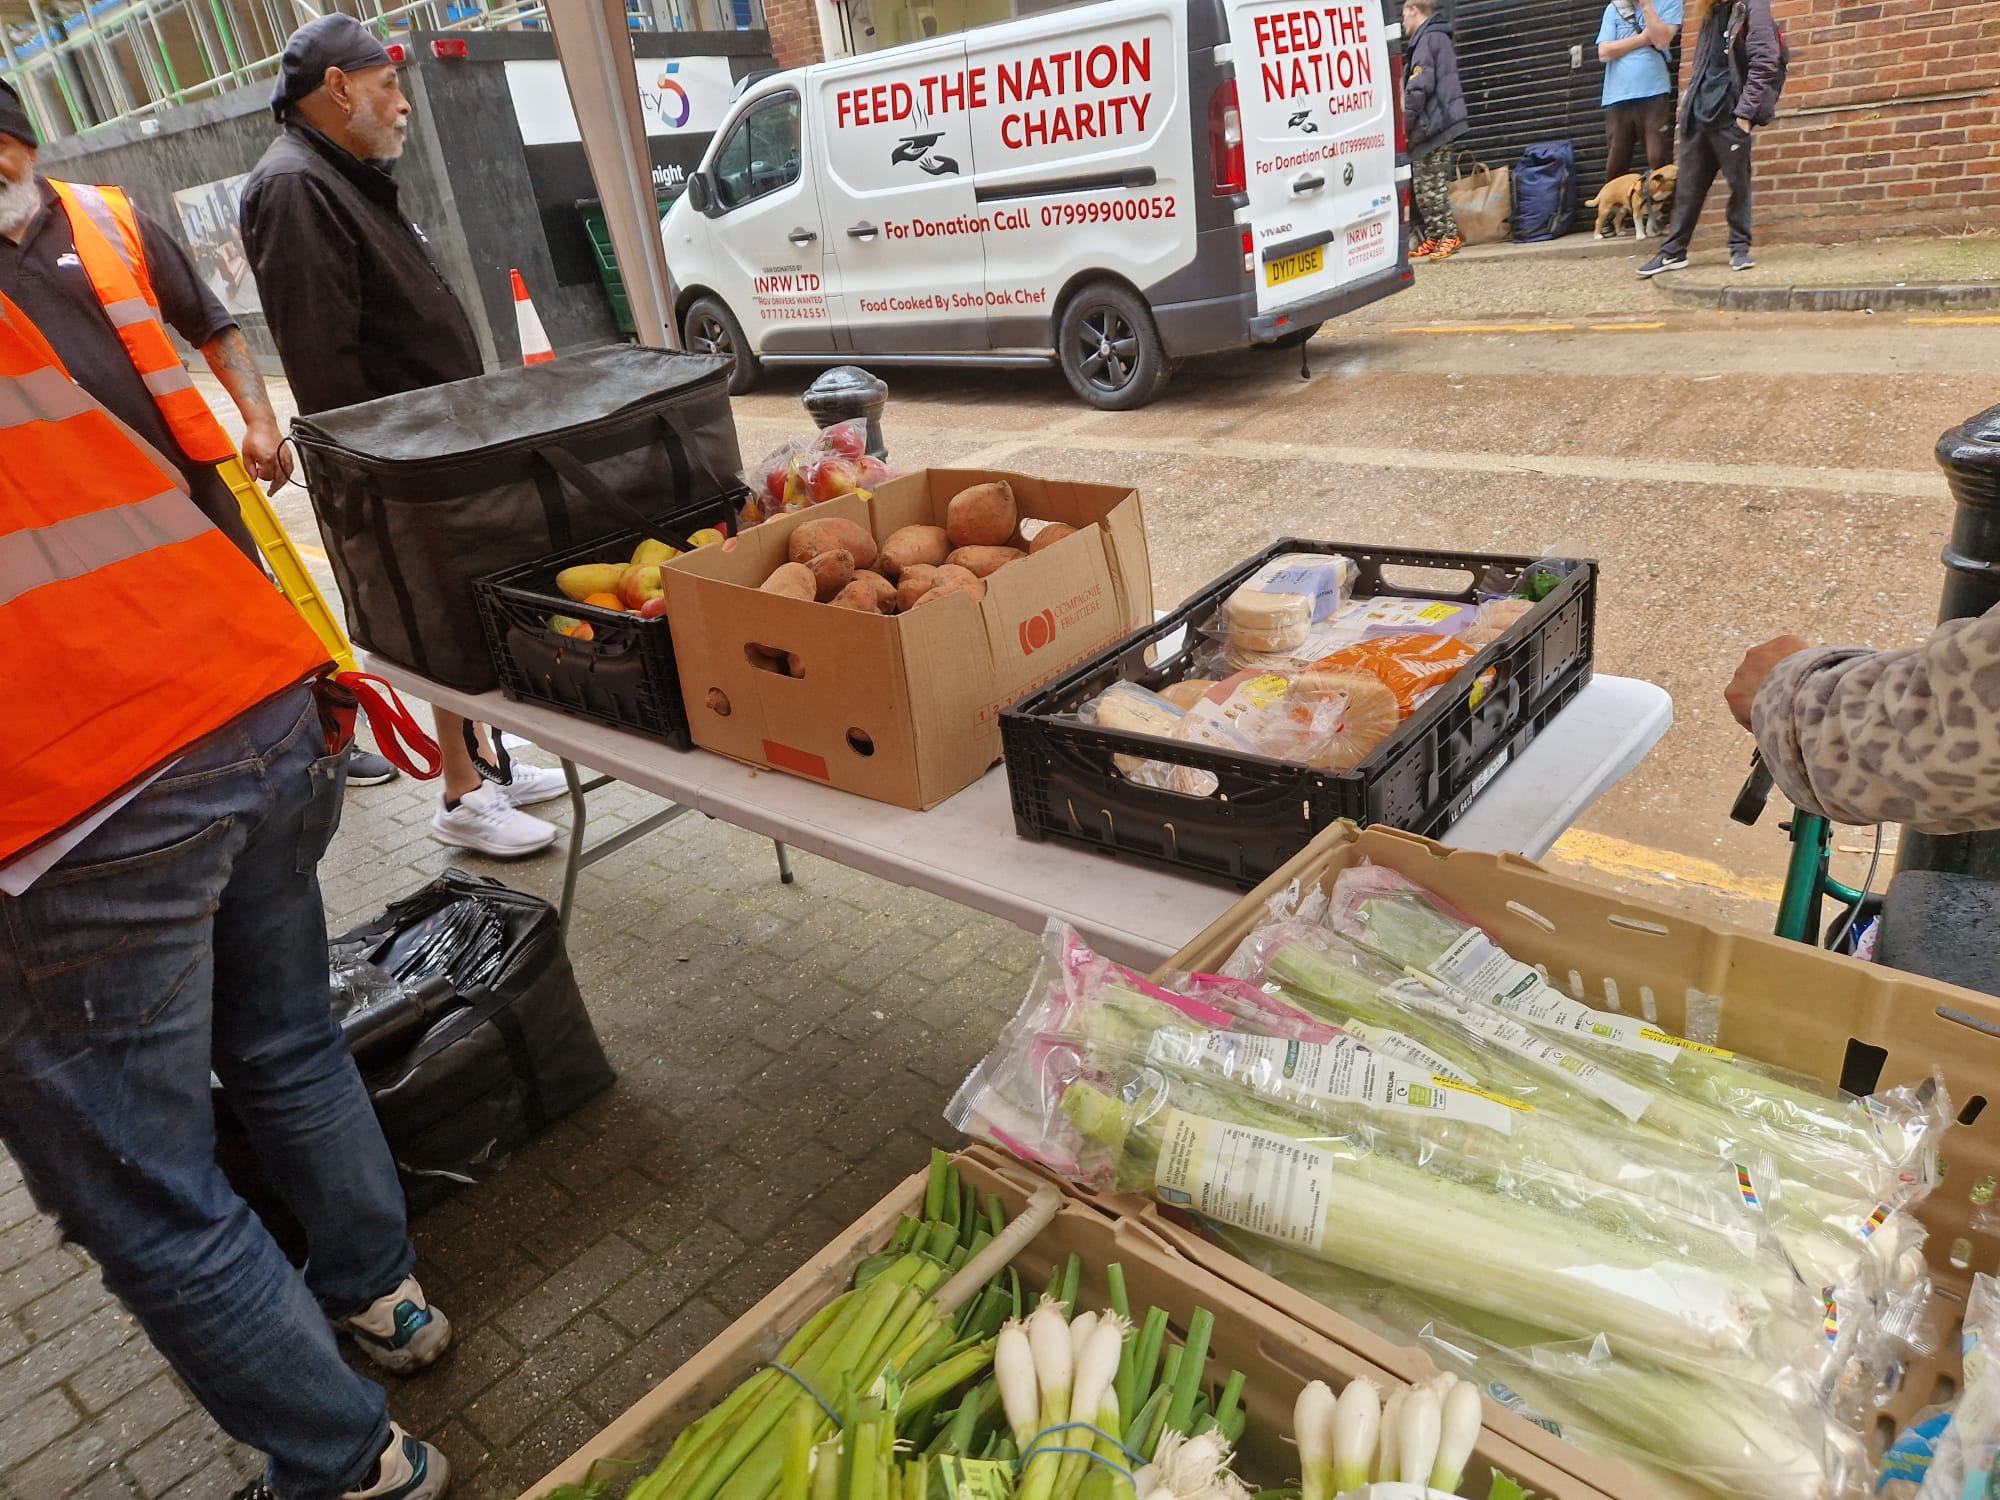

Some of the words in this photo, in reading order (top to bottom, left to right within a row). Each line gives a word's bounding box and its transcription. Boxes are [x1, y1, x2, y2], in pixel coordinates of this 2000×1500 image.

[1254, 12, 1322, 57] FEED
[1325, 6, 1367, 45] THE
[837, 81, 913, 129] FEED
[919, 67, 987, 116] THE
[997, 37, 1151, 105] NATION
[1261, 48, 1372, 103] NATION
[1328, 91, 1374, 116] CHARITY
[1001, 93, 1152, 150] CHARITY
[1256, 160, 1273, 175] For
[1275, 149, 1320, 170] Donation
[1321, 143, 1339, 159] Call
[884, 220, 910, 240] For
[913, 211, 991, 238] Donation
[994, 207, 1031, 231] Call
[1040, 196, 1177, 227] 07999900052
[1260, 224, 1292, 238] VIVARO
[1369, 222, 1382, 237] LTD
[1273, 257, 1295, 281] DY17
[1299, 251, 1318, 273] USE
[754, 275, 792, 293] INRW
[796, 273, 820, 291] LTD
[860, 298, 886, 313] Food
[886, 295, 933, 311] Cooked
[935, 294, 950, 310] By
[951, 291, 984, 308] Soho
[985, 289, 1013, 306] Oak
[1015, 287, 1046, 304] Chef
[1054, 584, 1102, 618] COMPAGNIE
